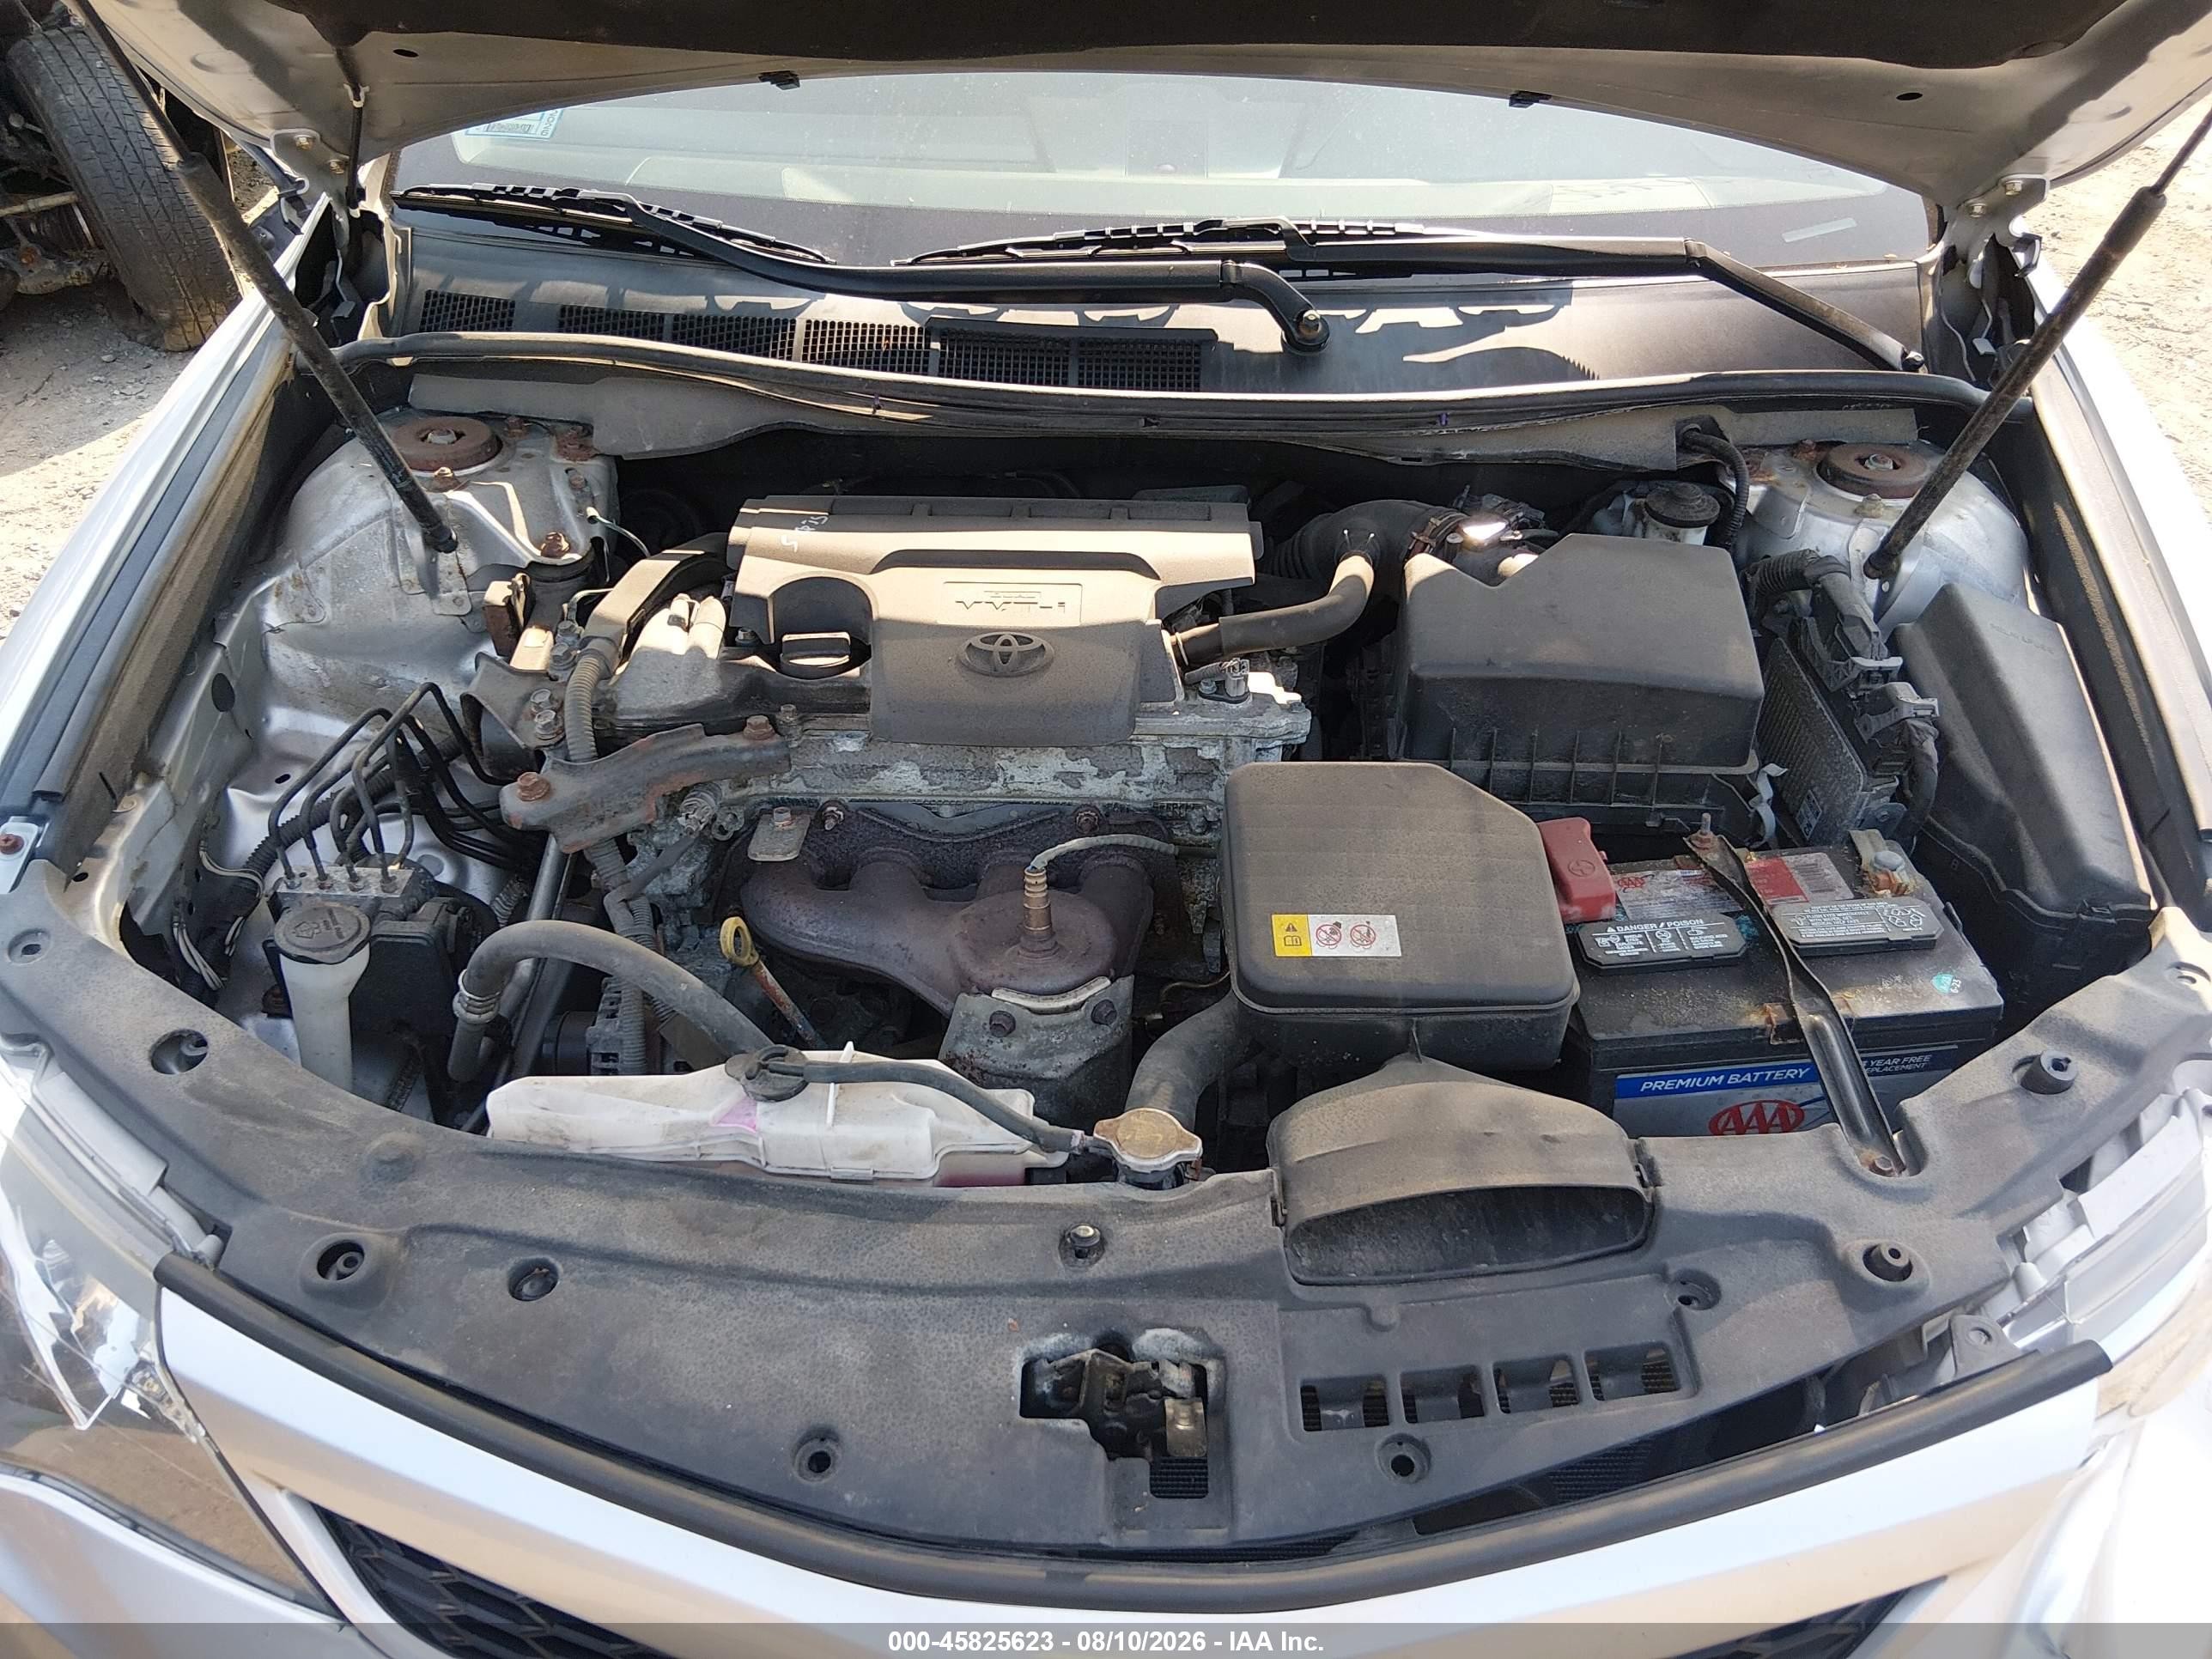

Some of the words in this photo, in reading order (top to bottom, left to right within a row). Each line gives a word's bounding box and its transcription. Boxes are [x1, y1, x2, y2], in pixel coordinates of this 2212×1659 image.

[1616, 923, 1657, 933] DANGER
[1667, 918, 1704, 927] POISON
[1869, 1057, 1900, 1068] YEAR
[1900, 1054, 1932, 1065] FREE
[1640, 1075, 1724, 1092] PREMIUM
[1726, 1066, 1810, 1085] BATTERY
[1712, 1100, 1804, 1134] AAA
